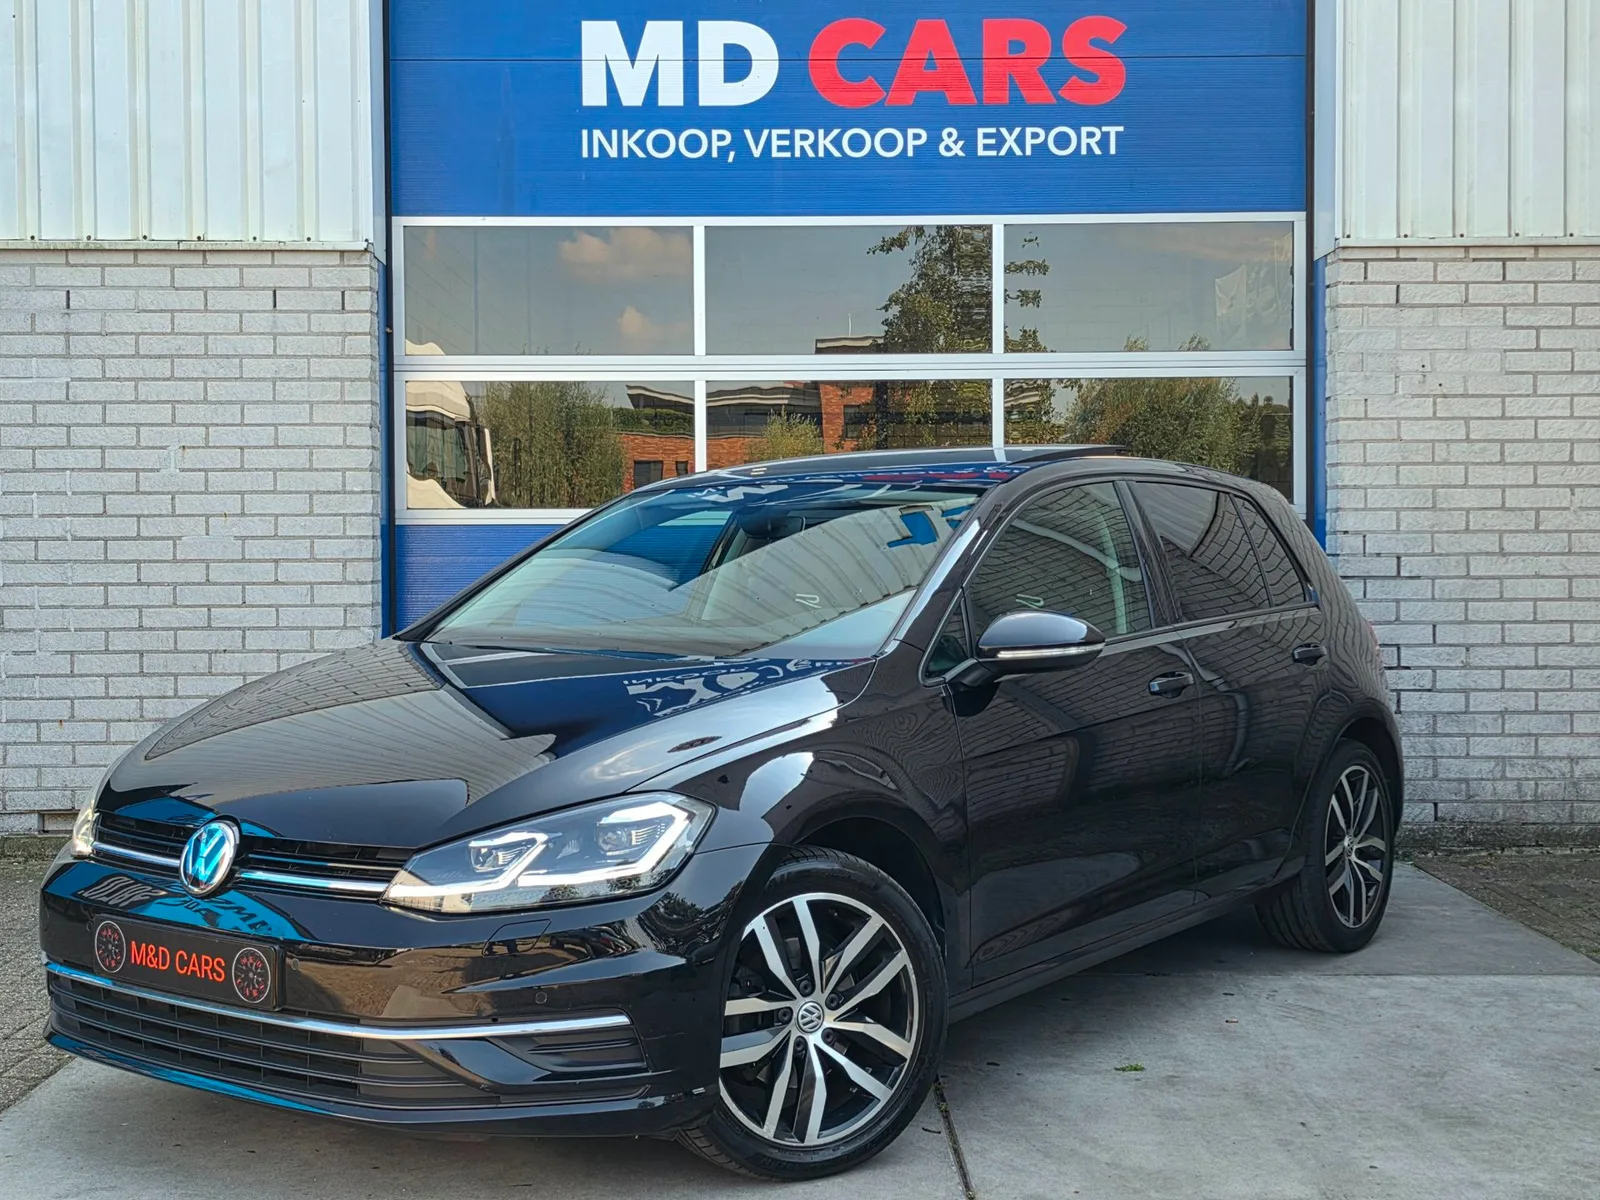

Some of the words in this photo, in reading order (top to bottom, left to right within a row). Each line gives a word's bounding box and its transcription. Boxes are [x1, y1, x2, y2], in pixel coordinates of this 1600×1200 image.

[581, 20, 779, 107] MD
[808, 15, 1127, 108] CARS
[581, 128, 735, 163] INKOOP,
[743, 128, 928, 158] VERKOOP
[938, 127, 965, 157] &
[976, 125, 1124, 157] EXPORT
[130, 940, 170, 970] M&D
[175, 950, 225, 982] CARS
